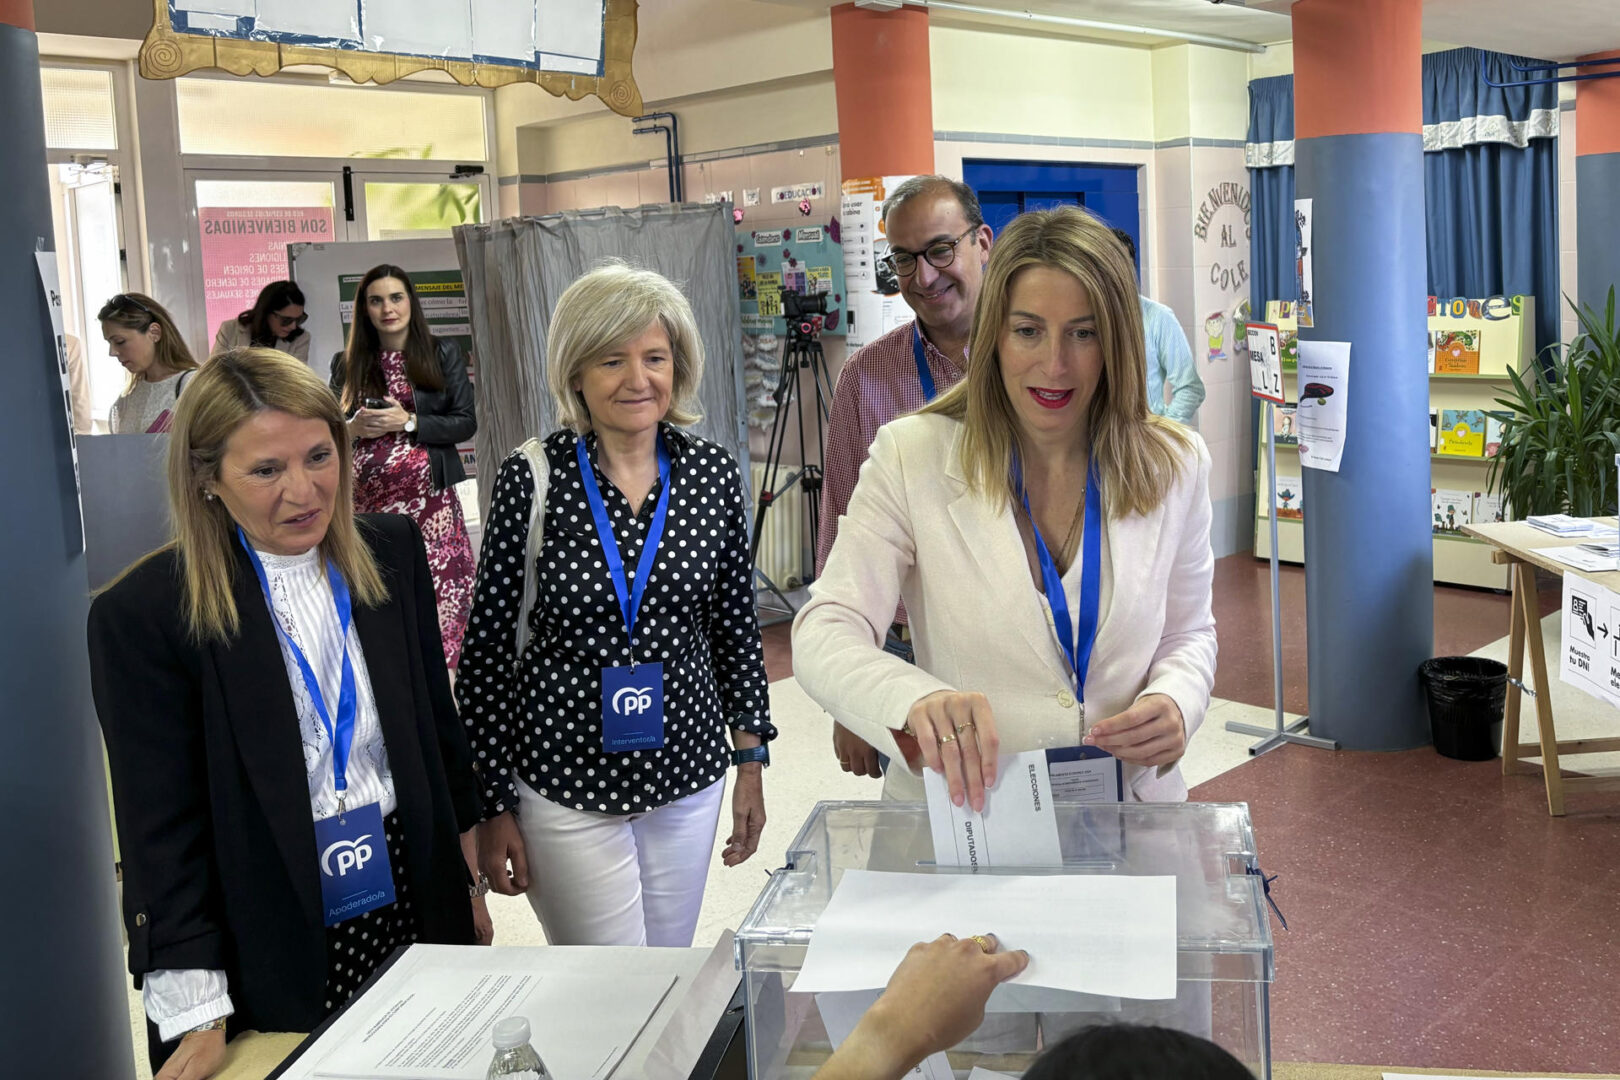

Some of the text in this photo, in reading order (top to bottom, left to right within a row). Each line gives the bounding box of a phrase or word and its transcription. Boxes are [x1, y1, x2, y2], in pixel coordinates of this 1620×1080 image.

[776, 186, 822, 200] CEDUCACIN
[1221, 224, 1237, 248] AL
[1210, 260, 1249, 293] COLE
[1269, 335, 1276, 356] B
[1249, 350, 1264, 363] MESA
[1262, 370, 1268, 390] L
[1569, 644, 1591, 662] Muestra
[1569, 655, 1590, 672] tu DNI
[612, 735, 656, 746] Interventor/a
[1028, 763, 1042, 813] ELECCIONES
[328, 890, 386, 918] Apoderado/a
